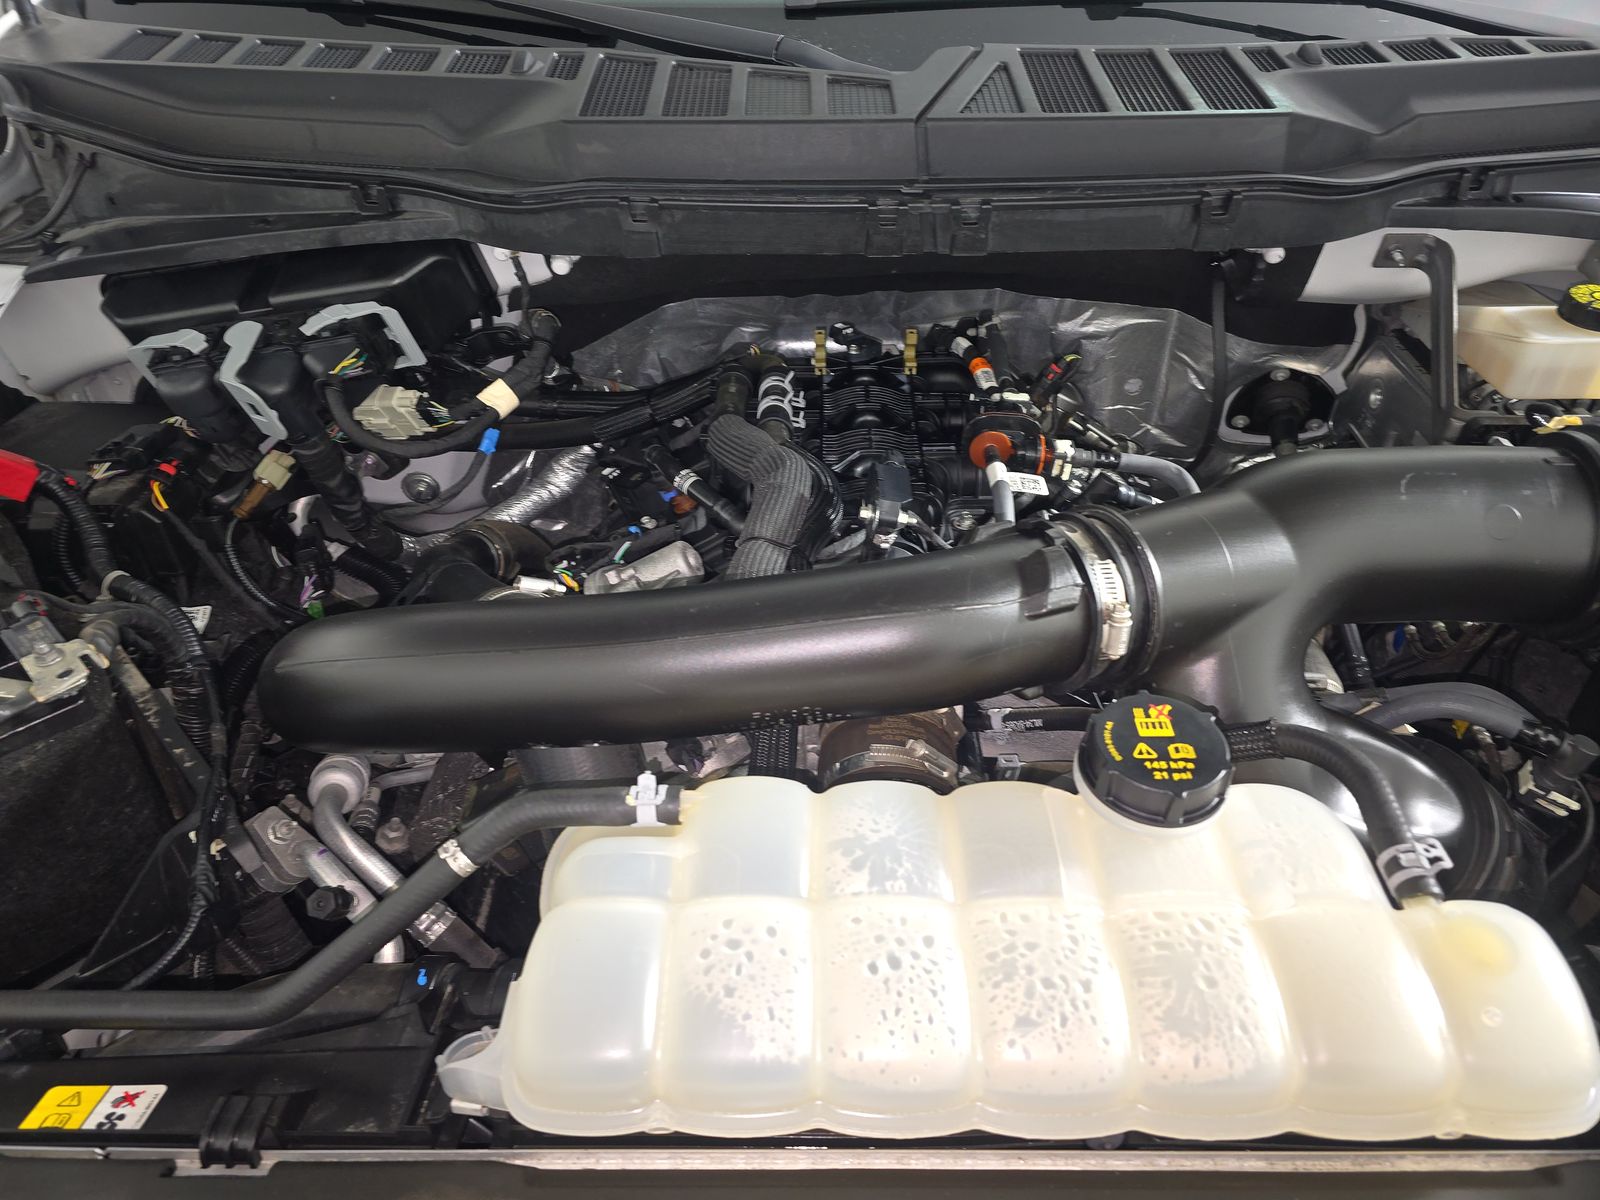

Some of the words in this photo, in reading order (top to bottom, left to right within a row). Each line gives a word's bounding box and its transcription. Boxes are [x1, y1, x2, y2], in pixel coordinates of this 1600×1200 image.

[1143, 760, 1169, 770] 145
[1169, 760, 1196, 770] kPa
[1152, 771, 1169, 780] 21
[1172, 770, 1193, 781] psi
